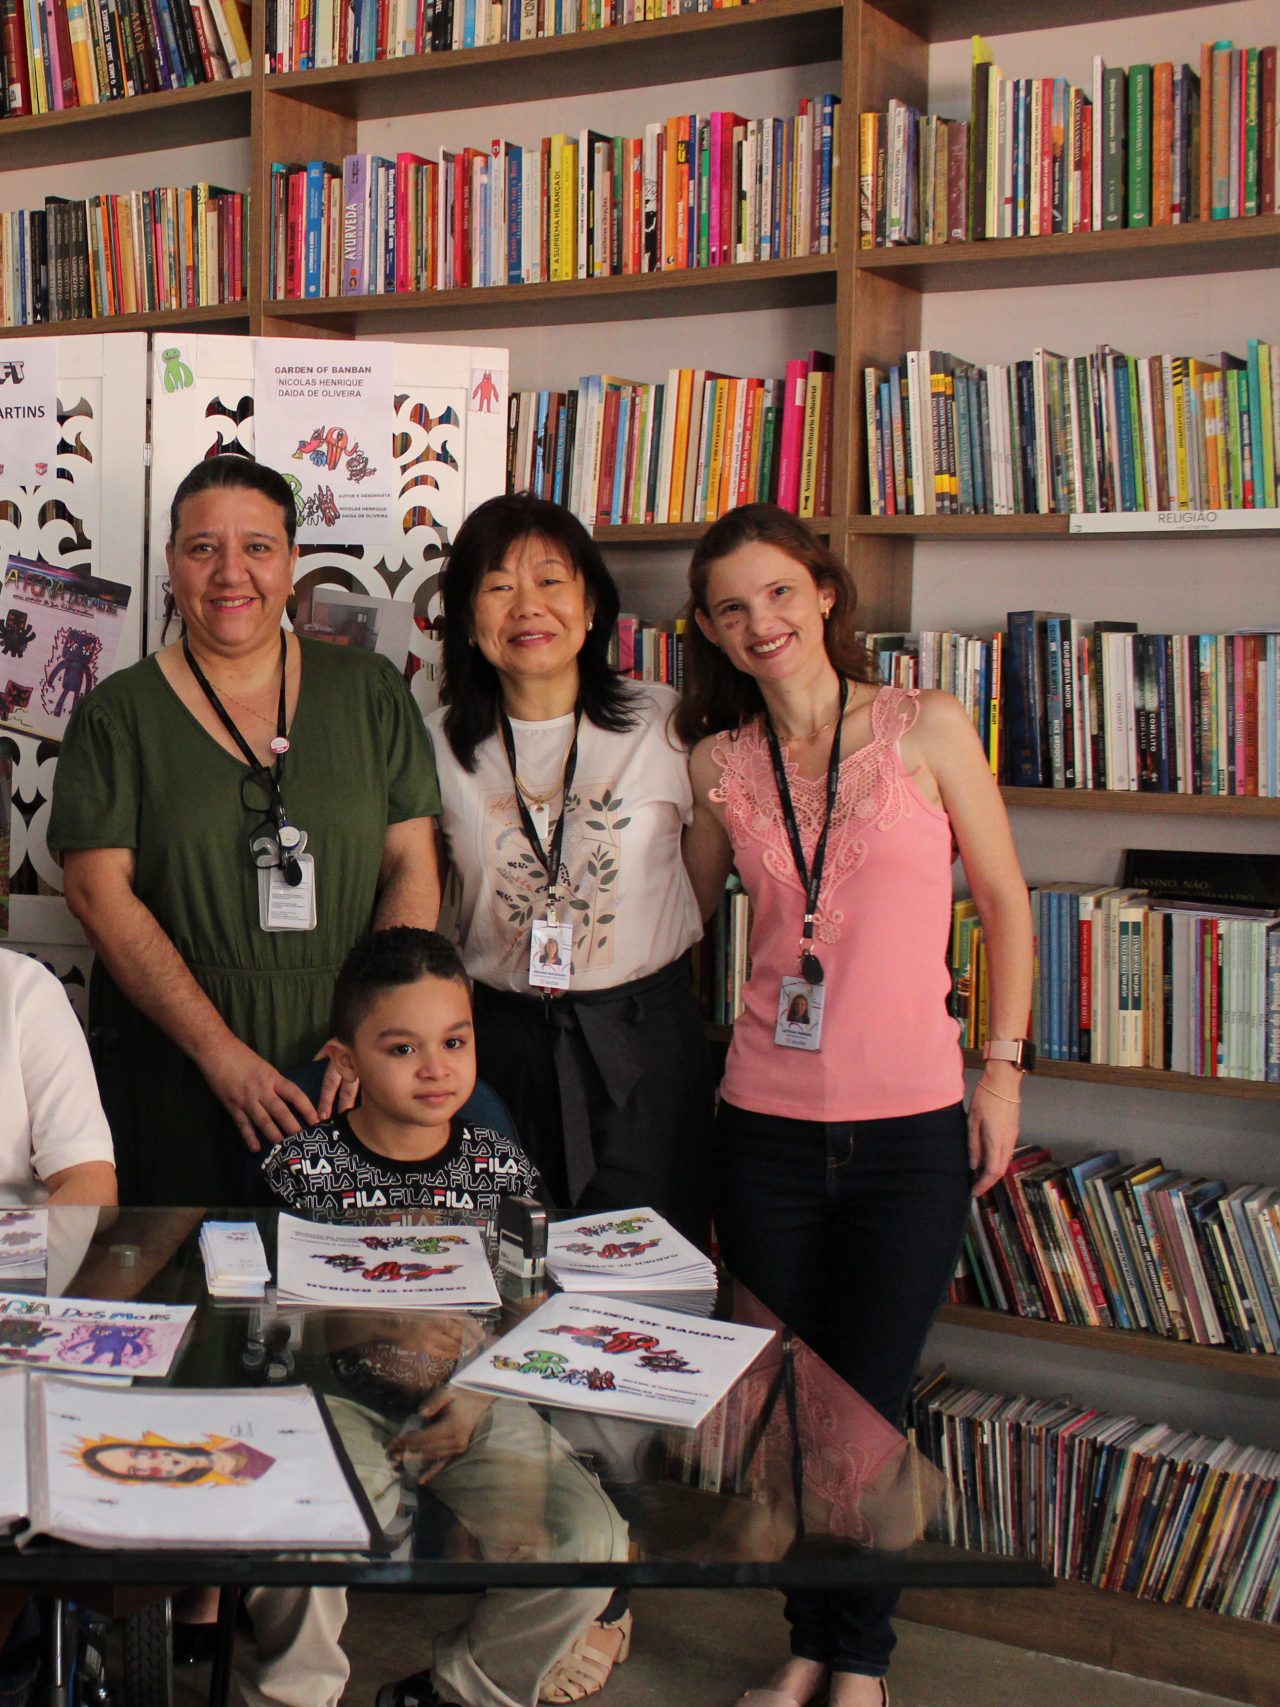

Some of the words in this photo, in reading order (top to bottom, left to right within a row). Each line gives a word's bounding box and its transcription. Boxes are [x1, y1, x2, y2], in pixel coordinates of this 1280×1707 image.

[102, 10, 110, 32] ESQUECE
[344, 203, 357, 260] AYURVEDA
[274, 366, 313, 374] GARDEN
[332, 366, 372, 374] BANBAN
[278, 378, 317, 387] NICOLAS
[320, 378, 364, 388] HENRIQUE
[278, 388, 305, 398] DAIDA
[308, 389, 318, 398] DE
[322, 389, 361, 398] OLIVEIRA
[806, 386, 817, 418] Industrial
[742, 431, 751, 449] tempo
[804, 420, 815, 457] Receituário
[1063, 641, 1071, 658] DEUS
[1063, 667, 1071, 682] ESTÁ
[1063, 684, 1071, 707] MORTO
[305, 1142, 349, 1158] FILA
[288, 1158, 332, 1174] FILA
[475, 1157, 518, 1174] FILA
[310, 1174, 354, 1192] FILA
[358, 1168, 400, 1186] FILA
[406, 1169, 447, 1186] FILA
[451, 1173, 492, 1190] FILA
[341, 1190, 386, 1209] FILA
[390, 1188, 433, 1206] FILA
[434, 1189, 474, 1209] FILA
[569, 1305, 634, 1322] GARDEN
[640, 1319, 662, 1328] OF
[666, 1325, 736, 1342] BANBAN
